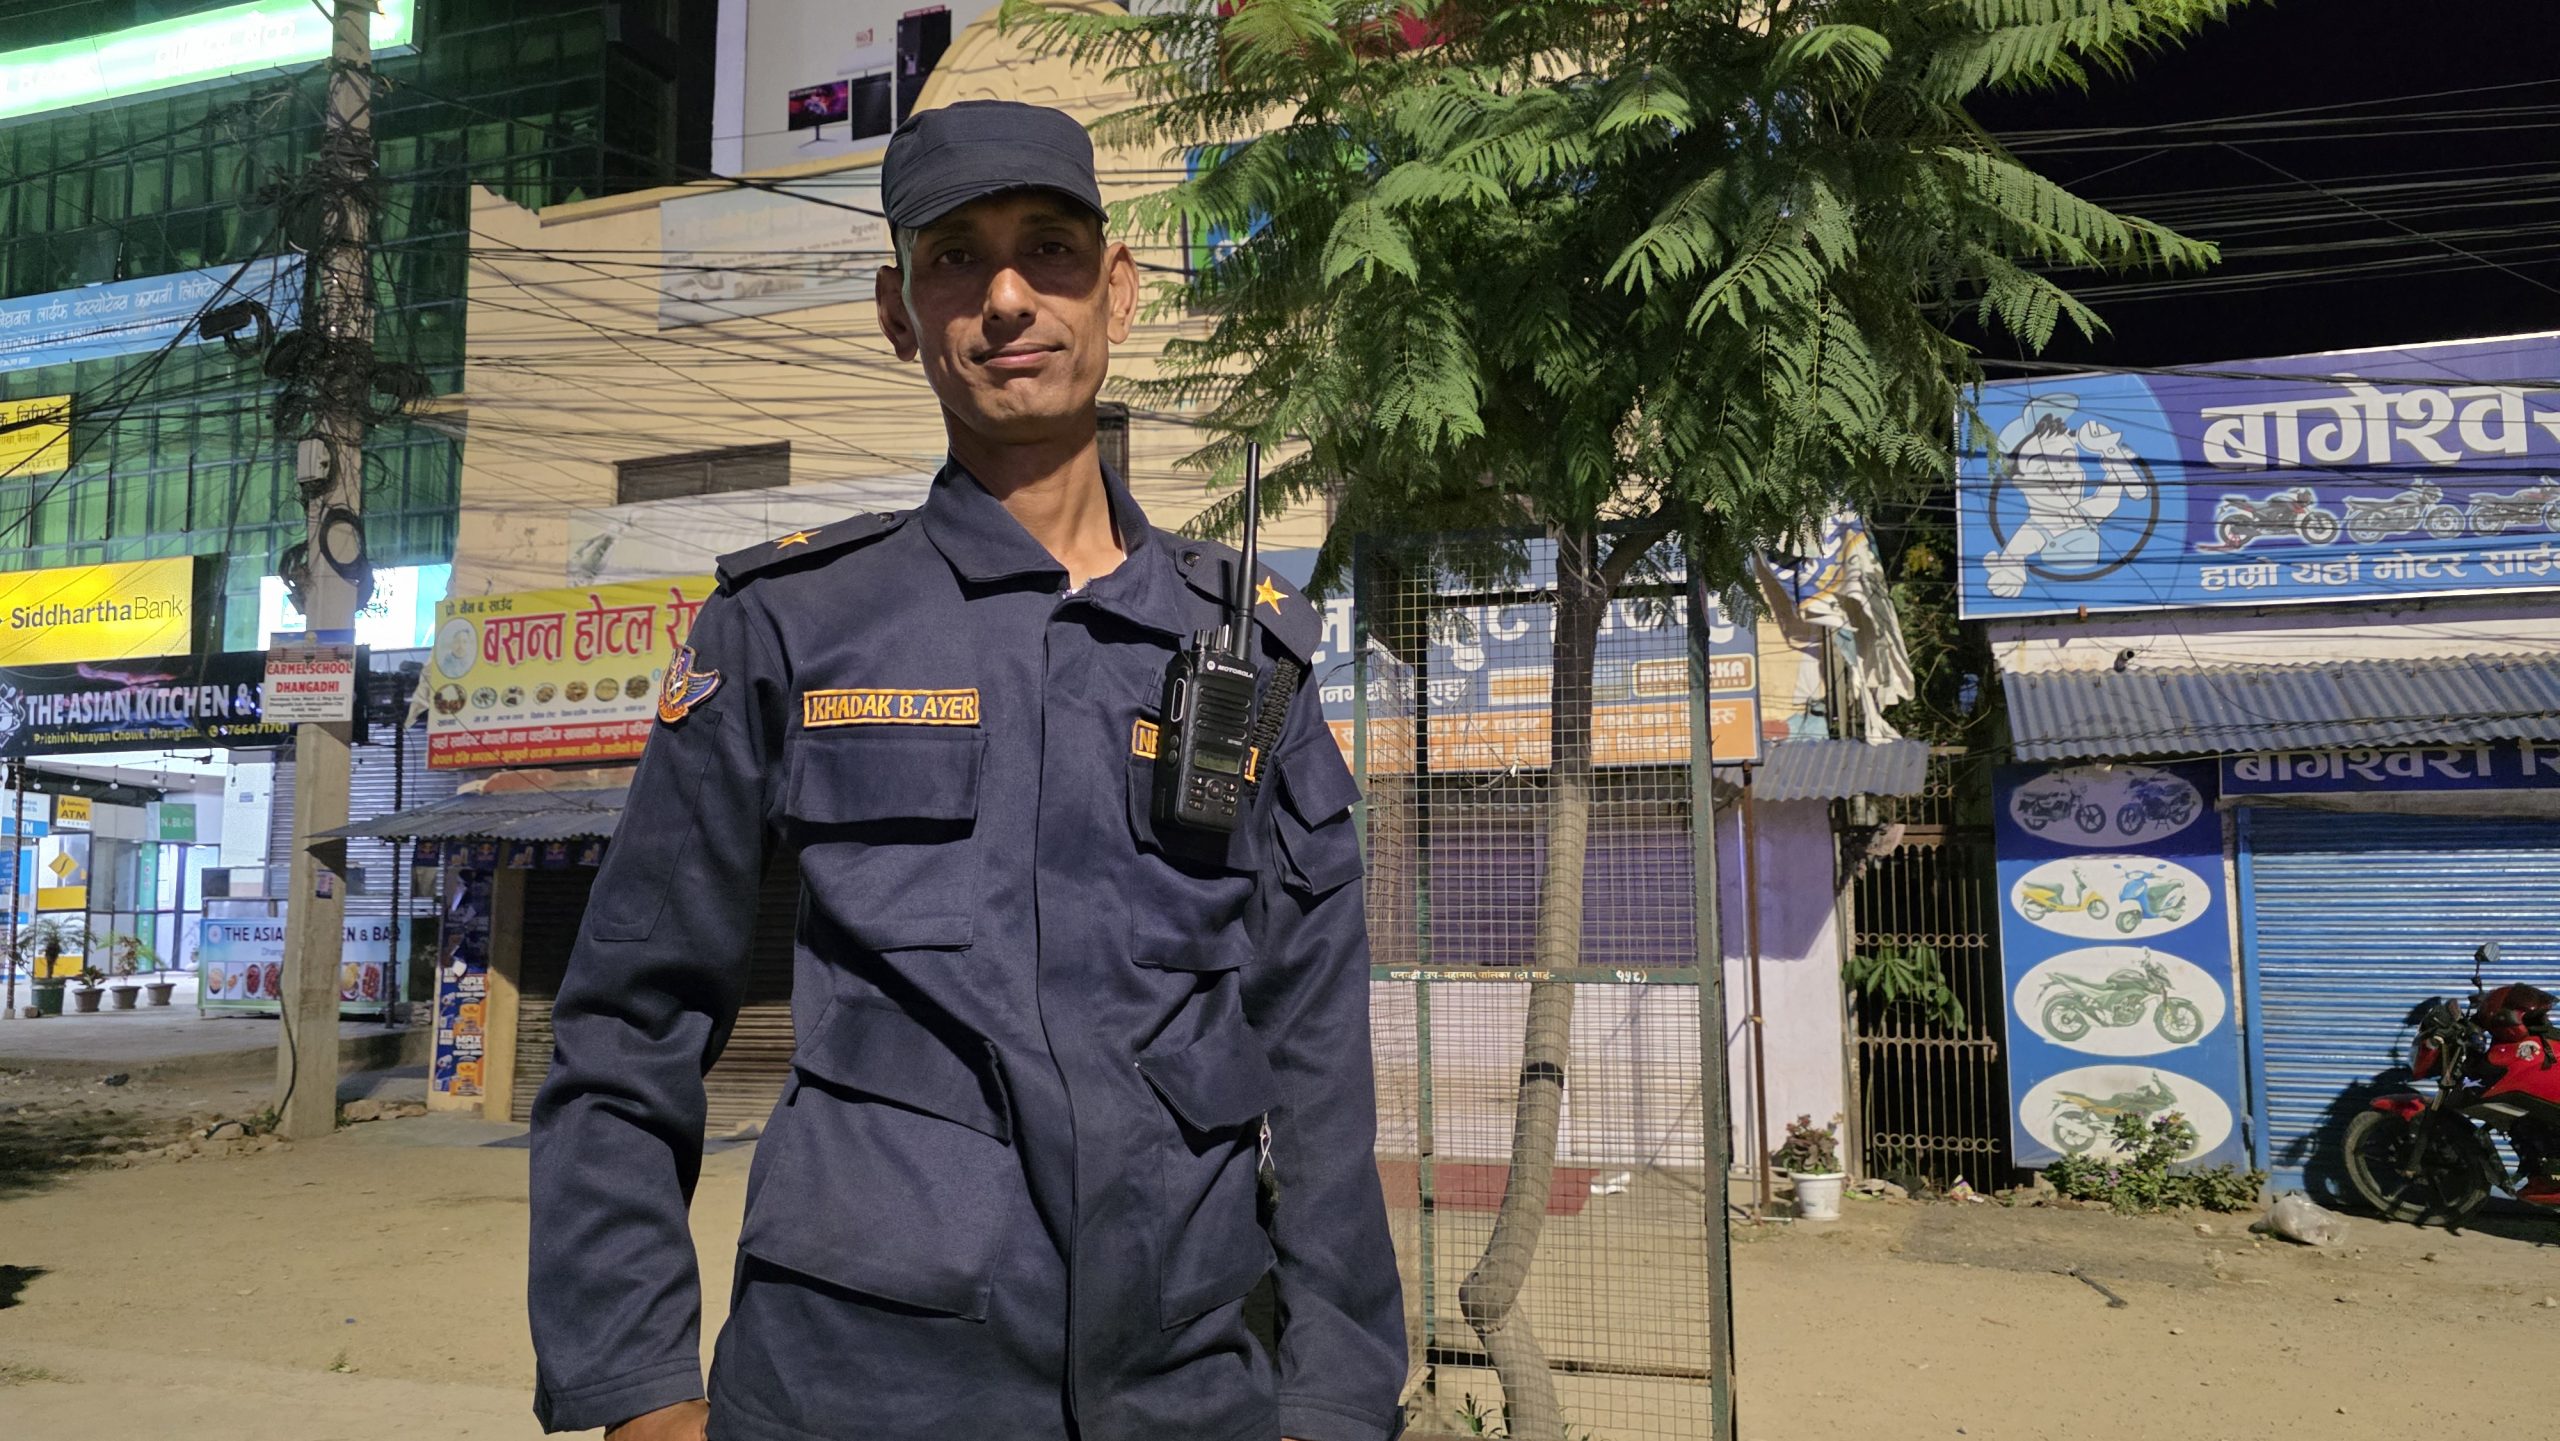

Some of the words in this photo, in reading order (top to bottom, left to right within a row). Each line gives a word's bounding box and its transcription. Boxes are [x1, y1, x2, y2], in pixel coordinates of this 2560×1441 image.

[0, 334, 42, 354] ATIONAL
[2373, 548, 2470, 580] मोटर
[483, 612, 566, 666] बसन्त
[574, 594, 656, 662] होटल
[267, 663, 306, 675] CARMEL
[309, 662, 352, 674] SCHOOL
[1217, 664, 1254, 679] MOTOROLA
[1640, 660, 1745, 683] MURRKA
[276, 681, 340, 693] DHANGADHI
[27, 693, 65, 726] THE
[68, 689, 131, 724] ASIAN
[135, 684, 229, 720] KITCHEN
[236, 683, 252, 716] &
[812, 695, 893, 720] KHADAK
[899, 694, 918, 718] B.
[921, 696, 975, 719] AYER
[220, 722, 290, 737] 766471701
[70, 730, 111, 745] Narayan
[61, 809, 87, 820] ATM
[21, 820, 34, 834] TM
[225, 926, 249, 941] THE
[253, 926, 285, 942] ASIA
